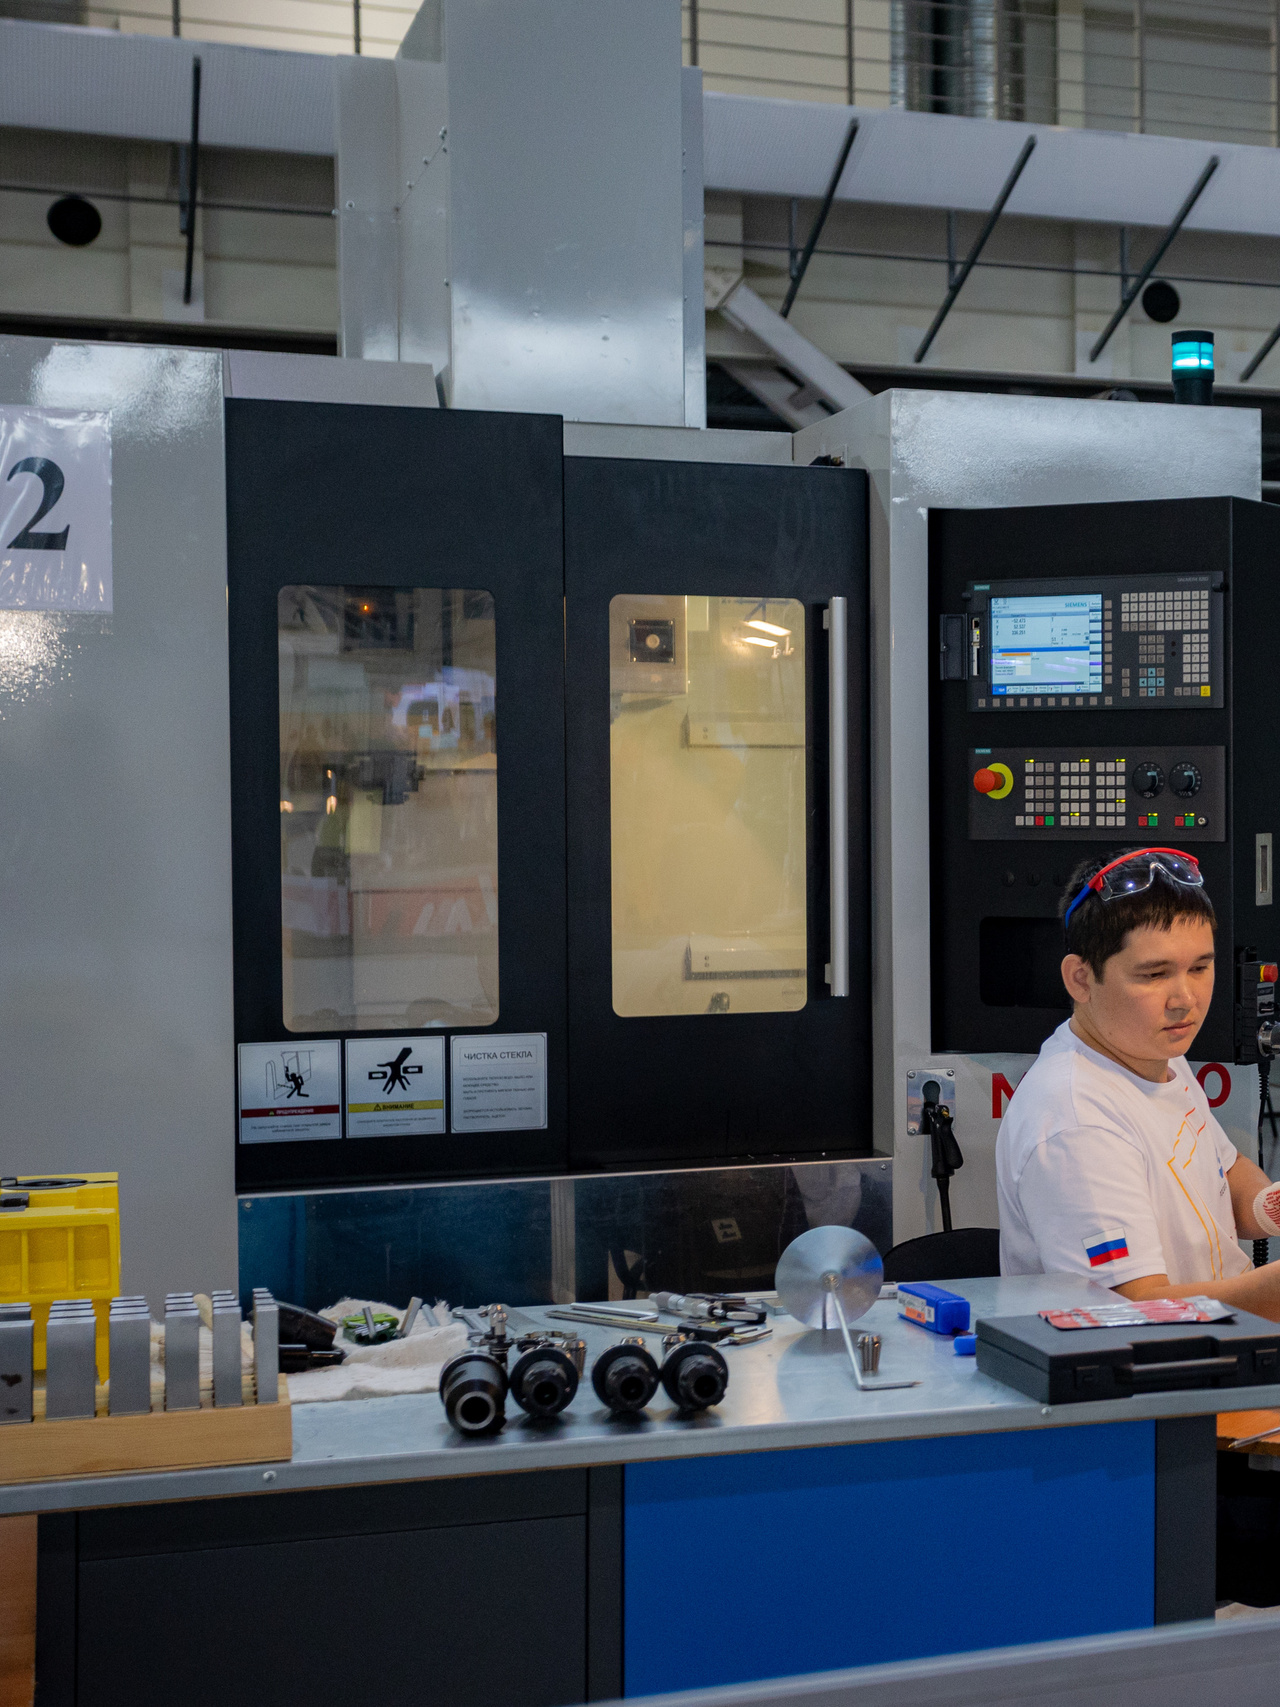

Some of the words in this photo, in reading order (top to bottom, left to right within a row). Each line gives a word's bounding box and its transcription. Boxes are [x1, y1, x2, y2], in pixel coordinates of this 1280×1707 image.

[6, 456, 70, 551] 2
[463, 1052, 498, 1060] ЧИСТКА
[500, 1050, 533, 1059] СТЕКЛА
[382, 1103, 415, 1111] ВНИМАНИЕ
